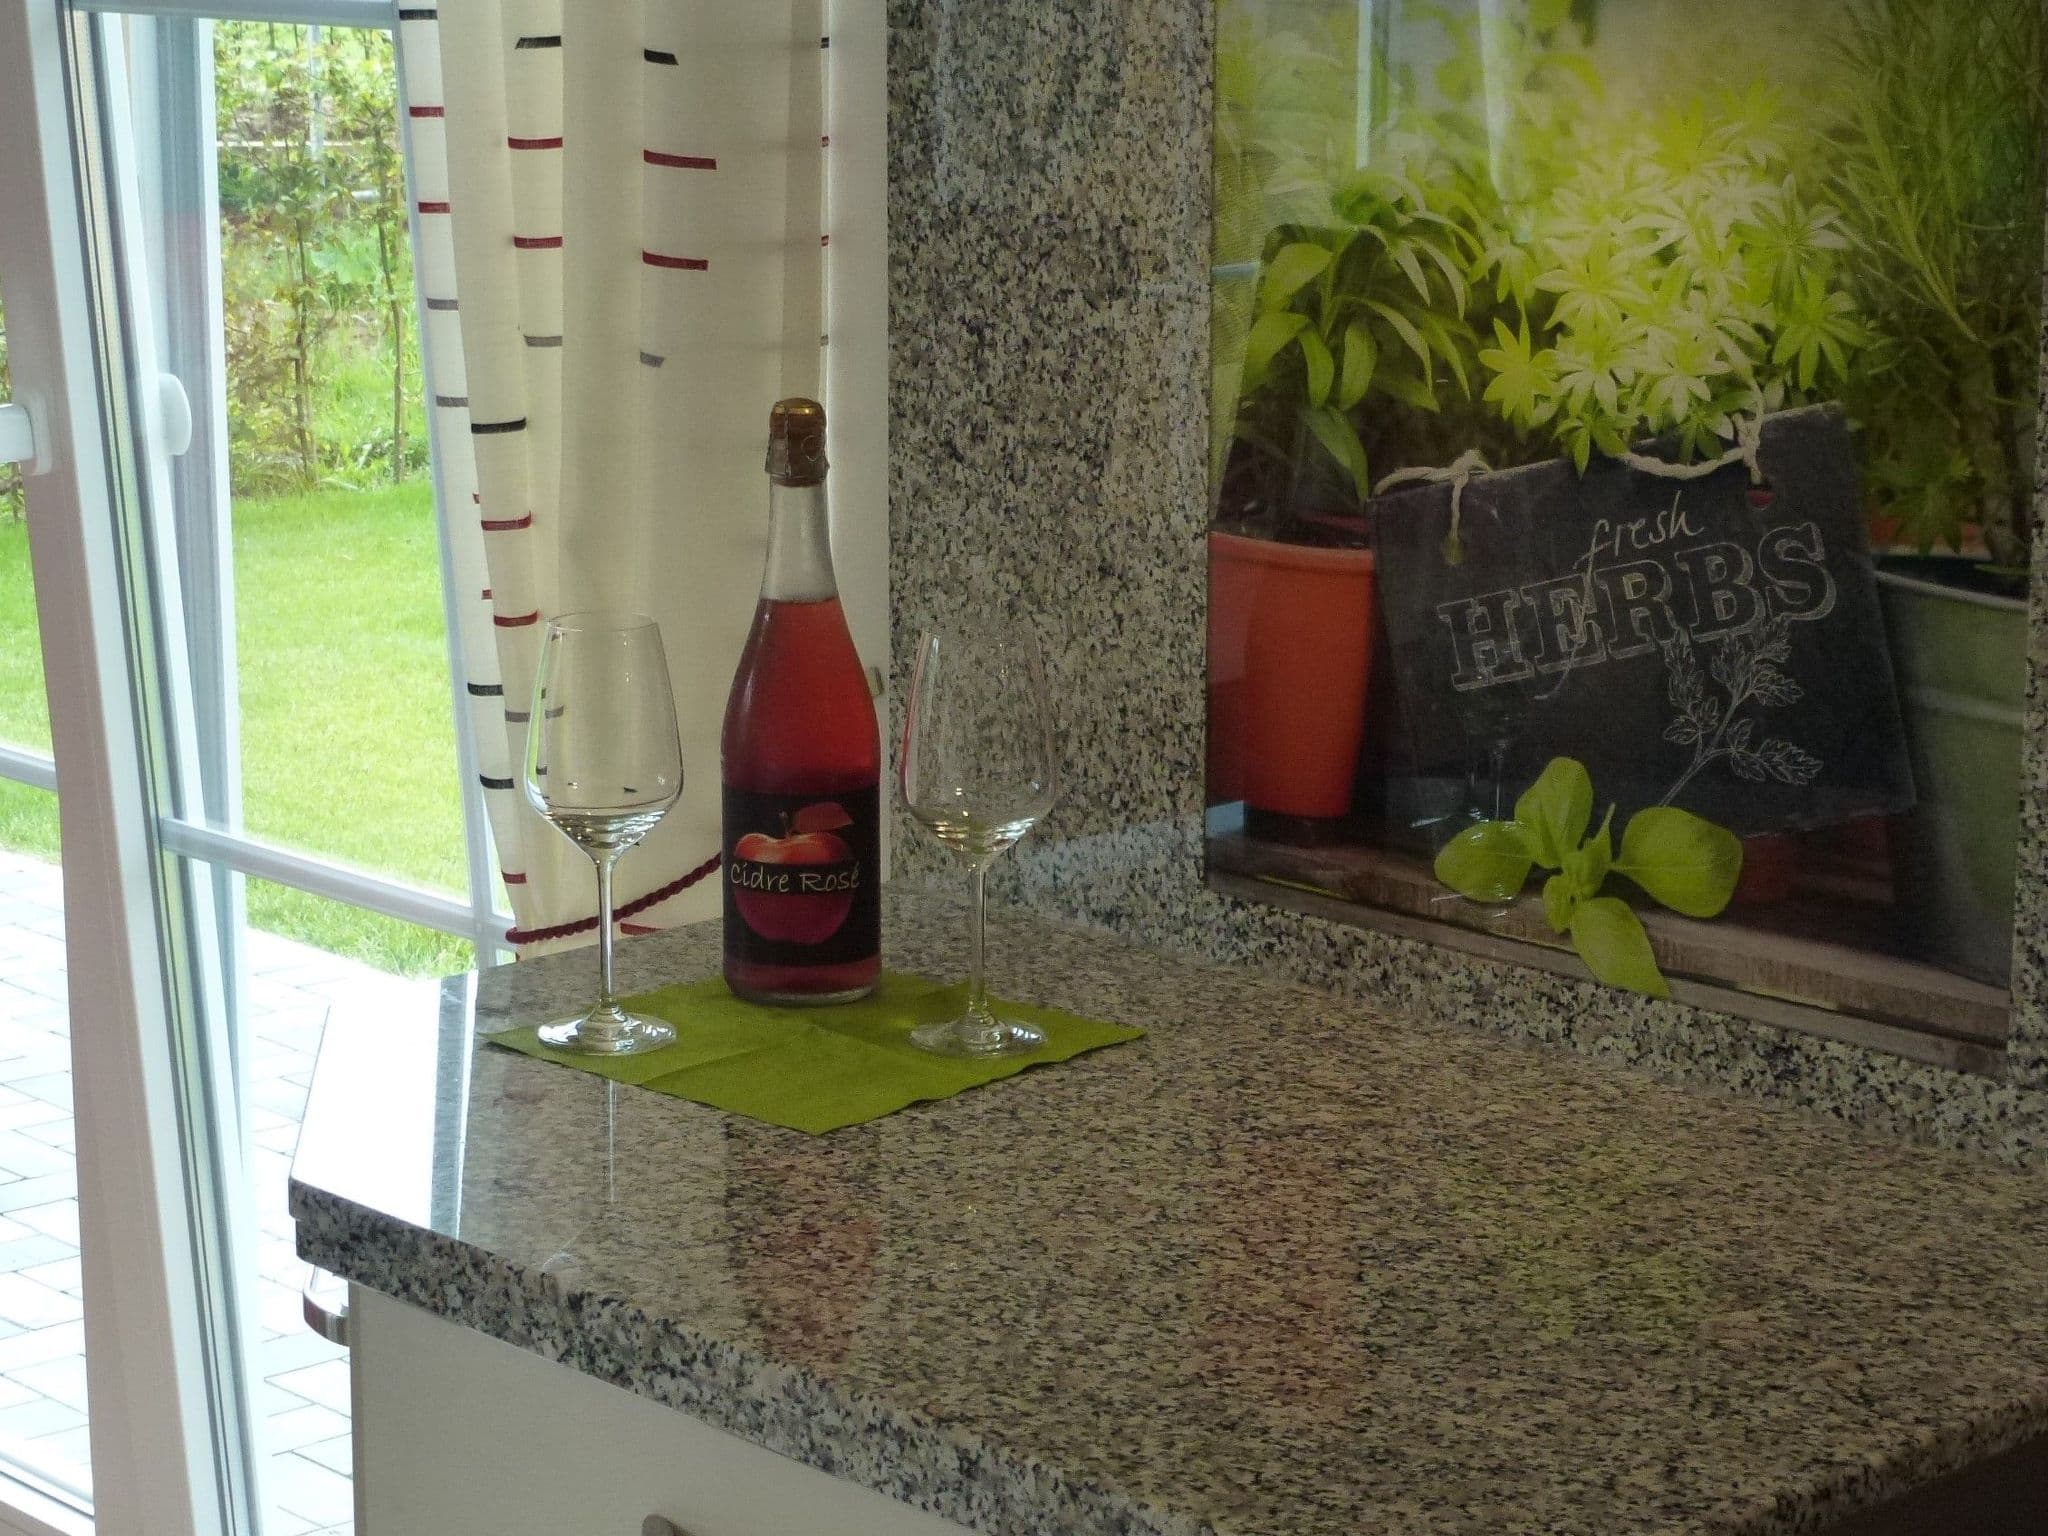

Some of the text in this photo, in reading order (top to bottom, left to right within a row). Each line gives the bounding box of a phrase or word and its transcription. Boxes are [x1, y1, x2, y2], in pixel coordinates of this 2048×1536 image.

[1437, 521, 1837, 692] HERBS
[730, 860, 860, 893] Cidre Rosé
